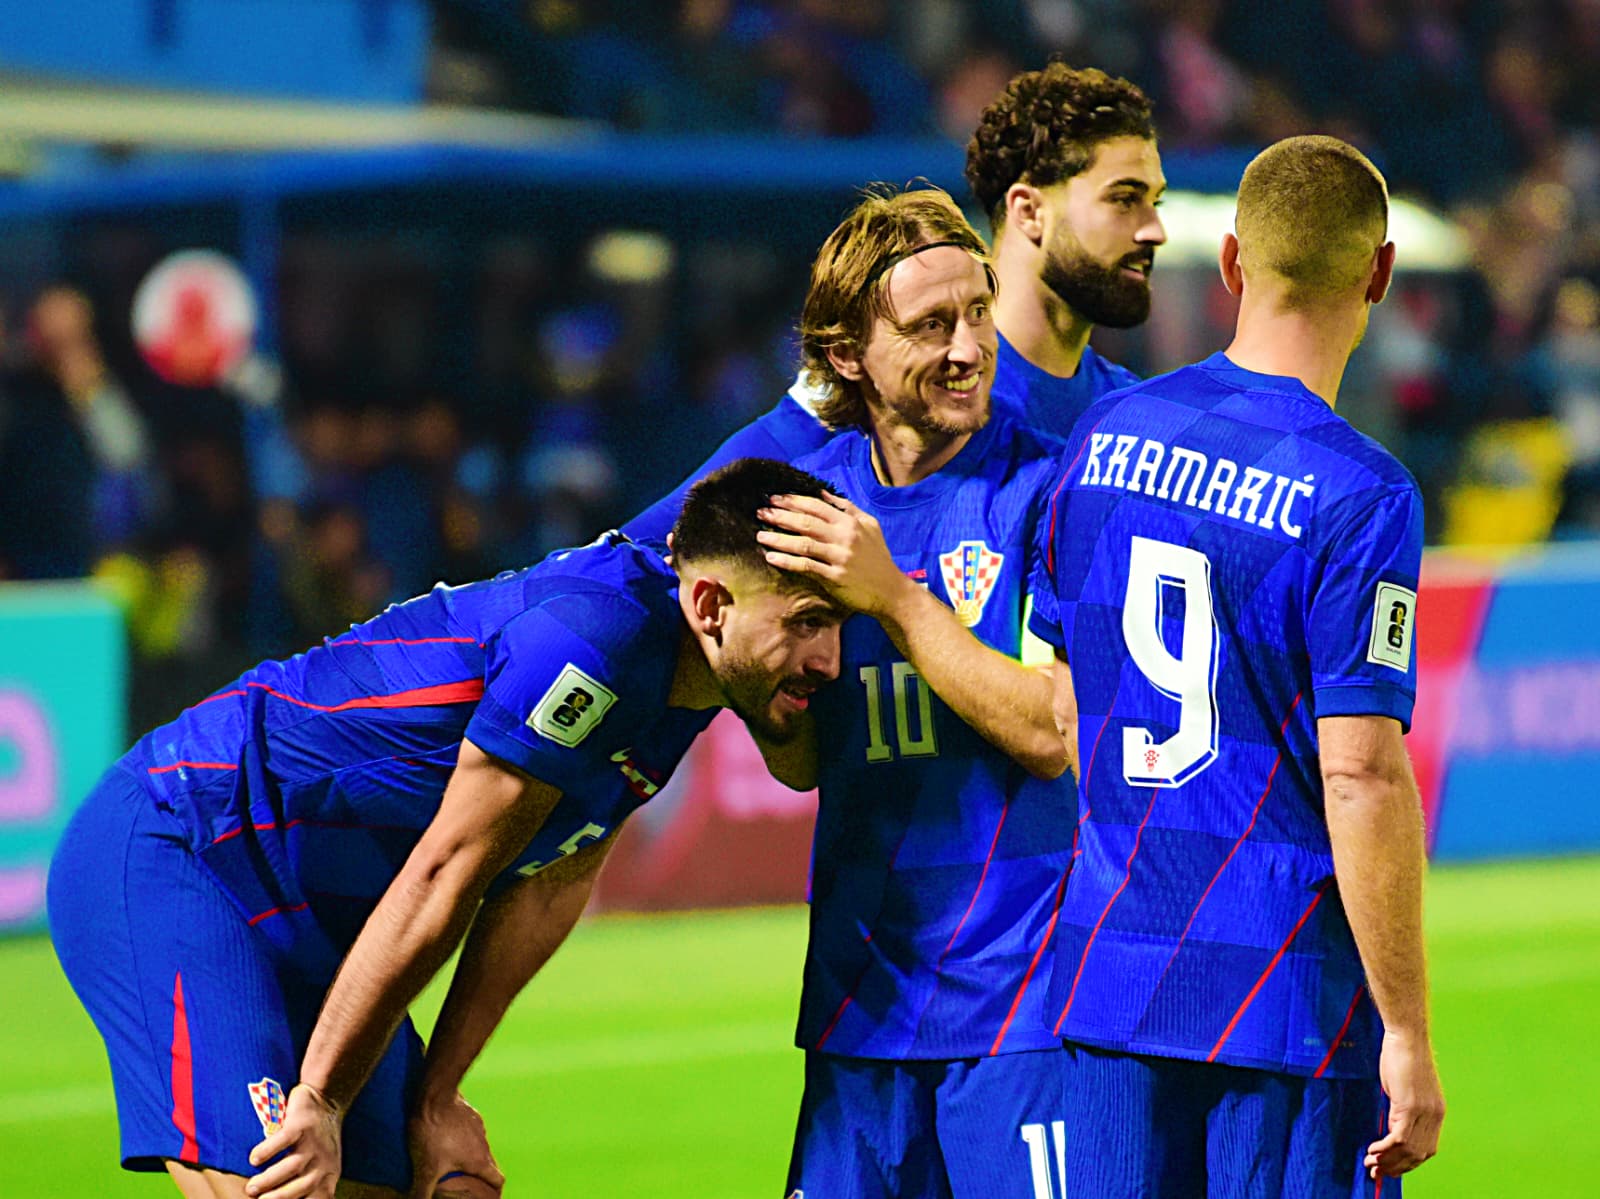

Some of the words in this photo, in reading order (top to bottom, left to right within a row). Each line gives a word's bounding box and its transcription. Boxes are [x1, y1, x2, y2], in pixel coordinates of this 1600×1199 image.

[1080, 433, 1314, 538] KRAMARIĆ
[859, 662, 939, 763] 10
[1122, 536, 1219, 788] 9
